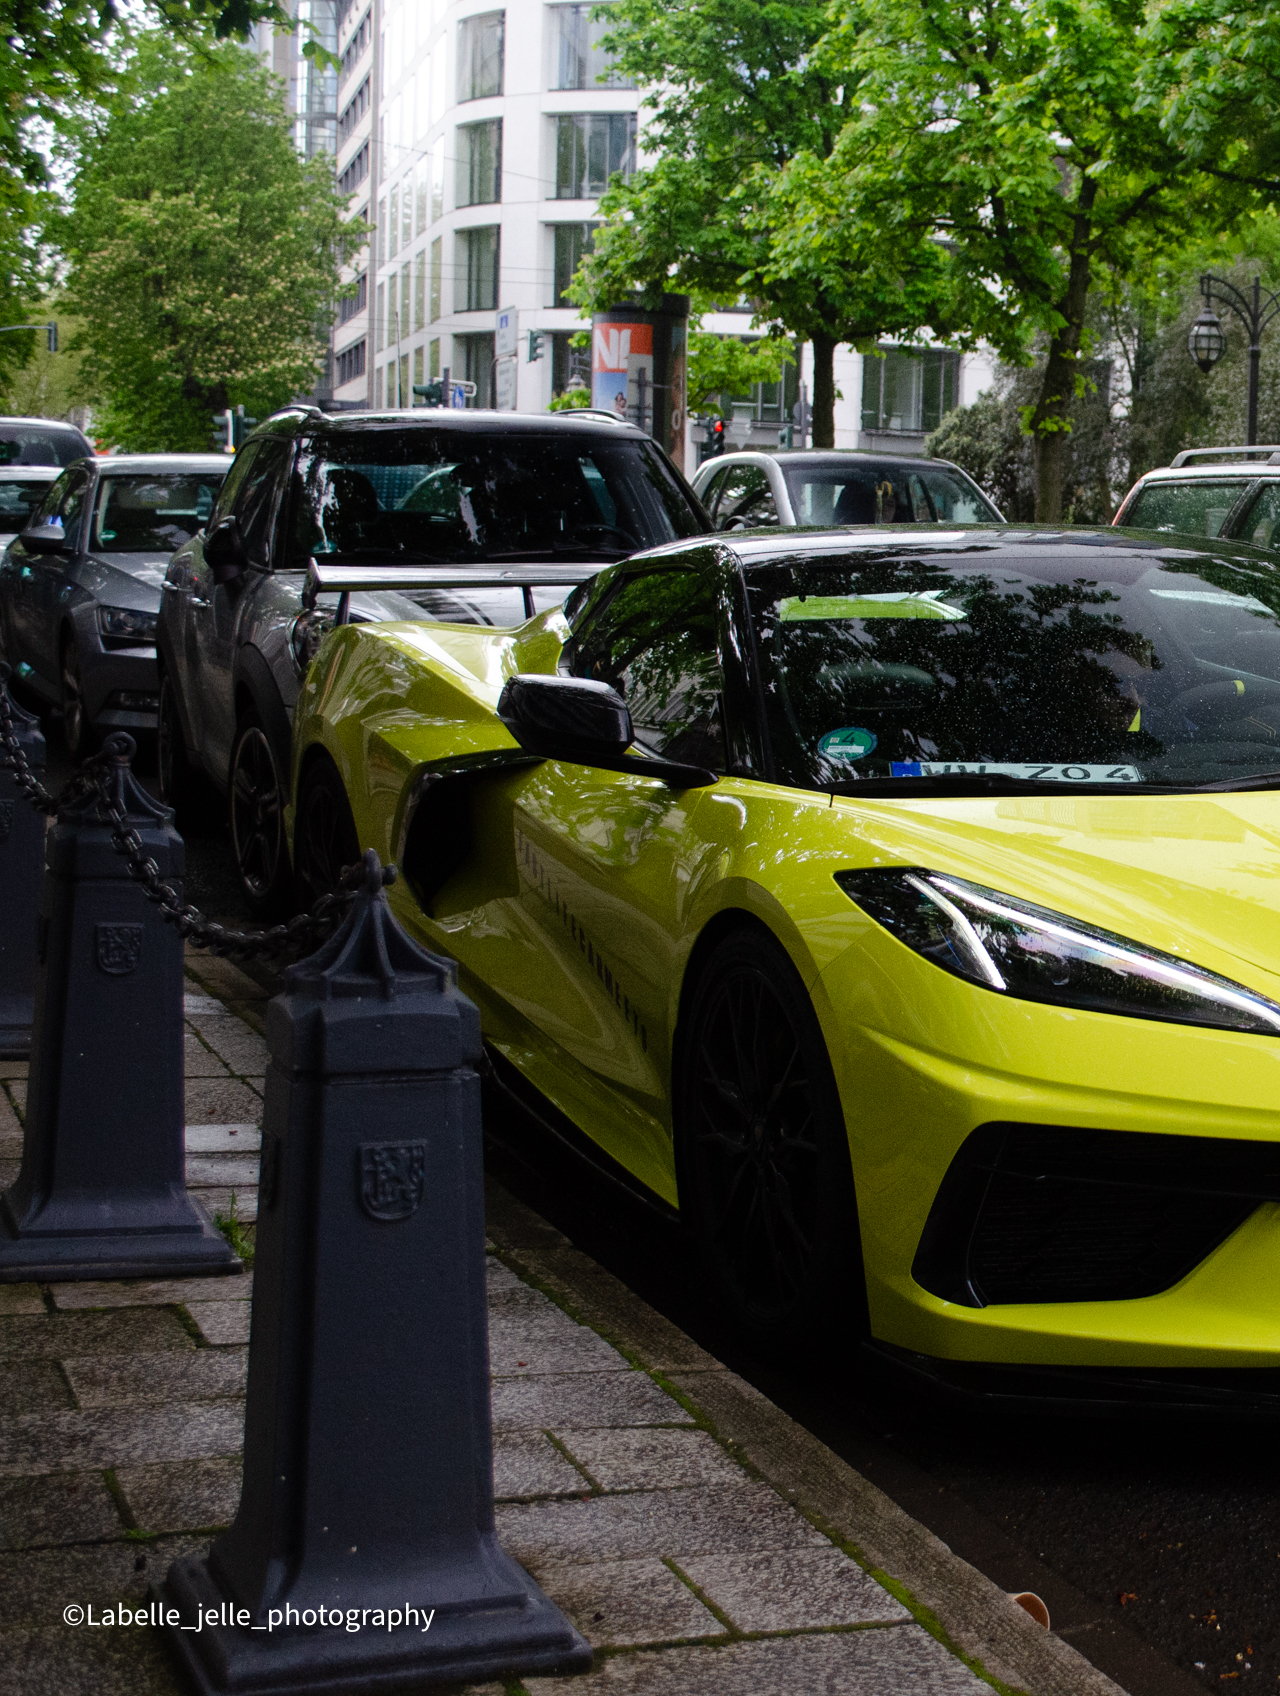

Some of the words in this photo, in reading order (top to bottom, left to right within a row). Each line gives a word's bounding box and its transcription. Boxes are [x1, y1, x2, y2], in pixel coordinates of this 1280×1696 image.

[842, 731, 855, 745] 4
[1024, 766, 1090, 780] ZO
[1105, 767, 1134, 781] 4
